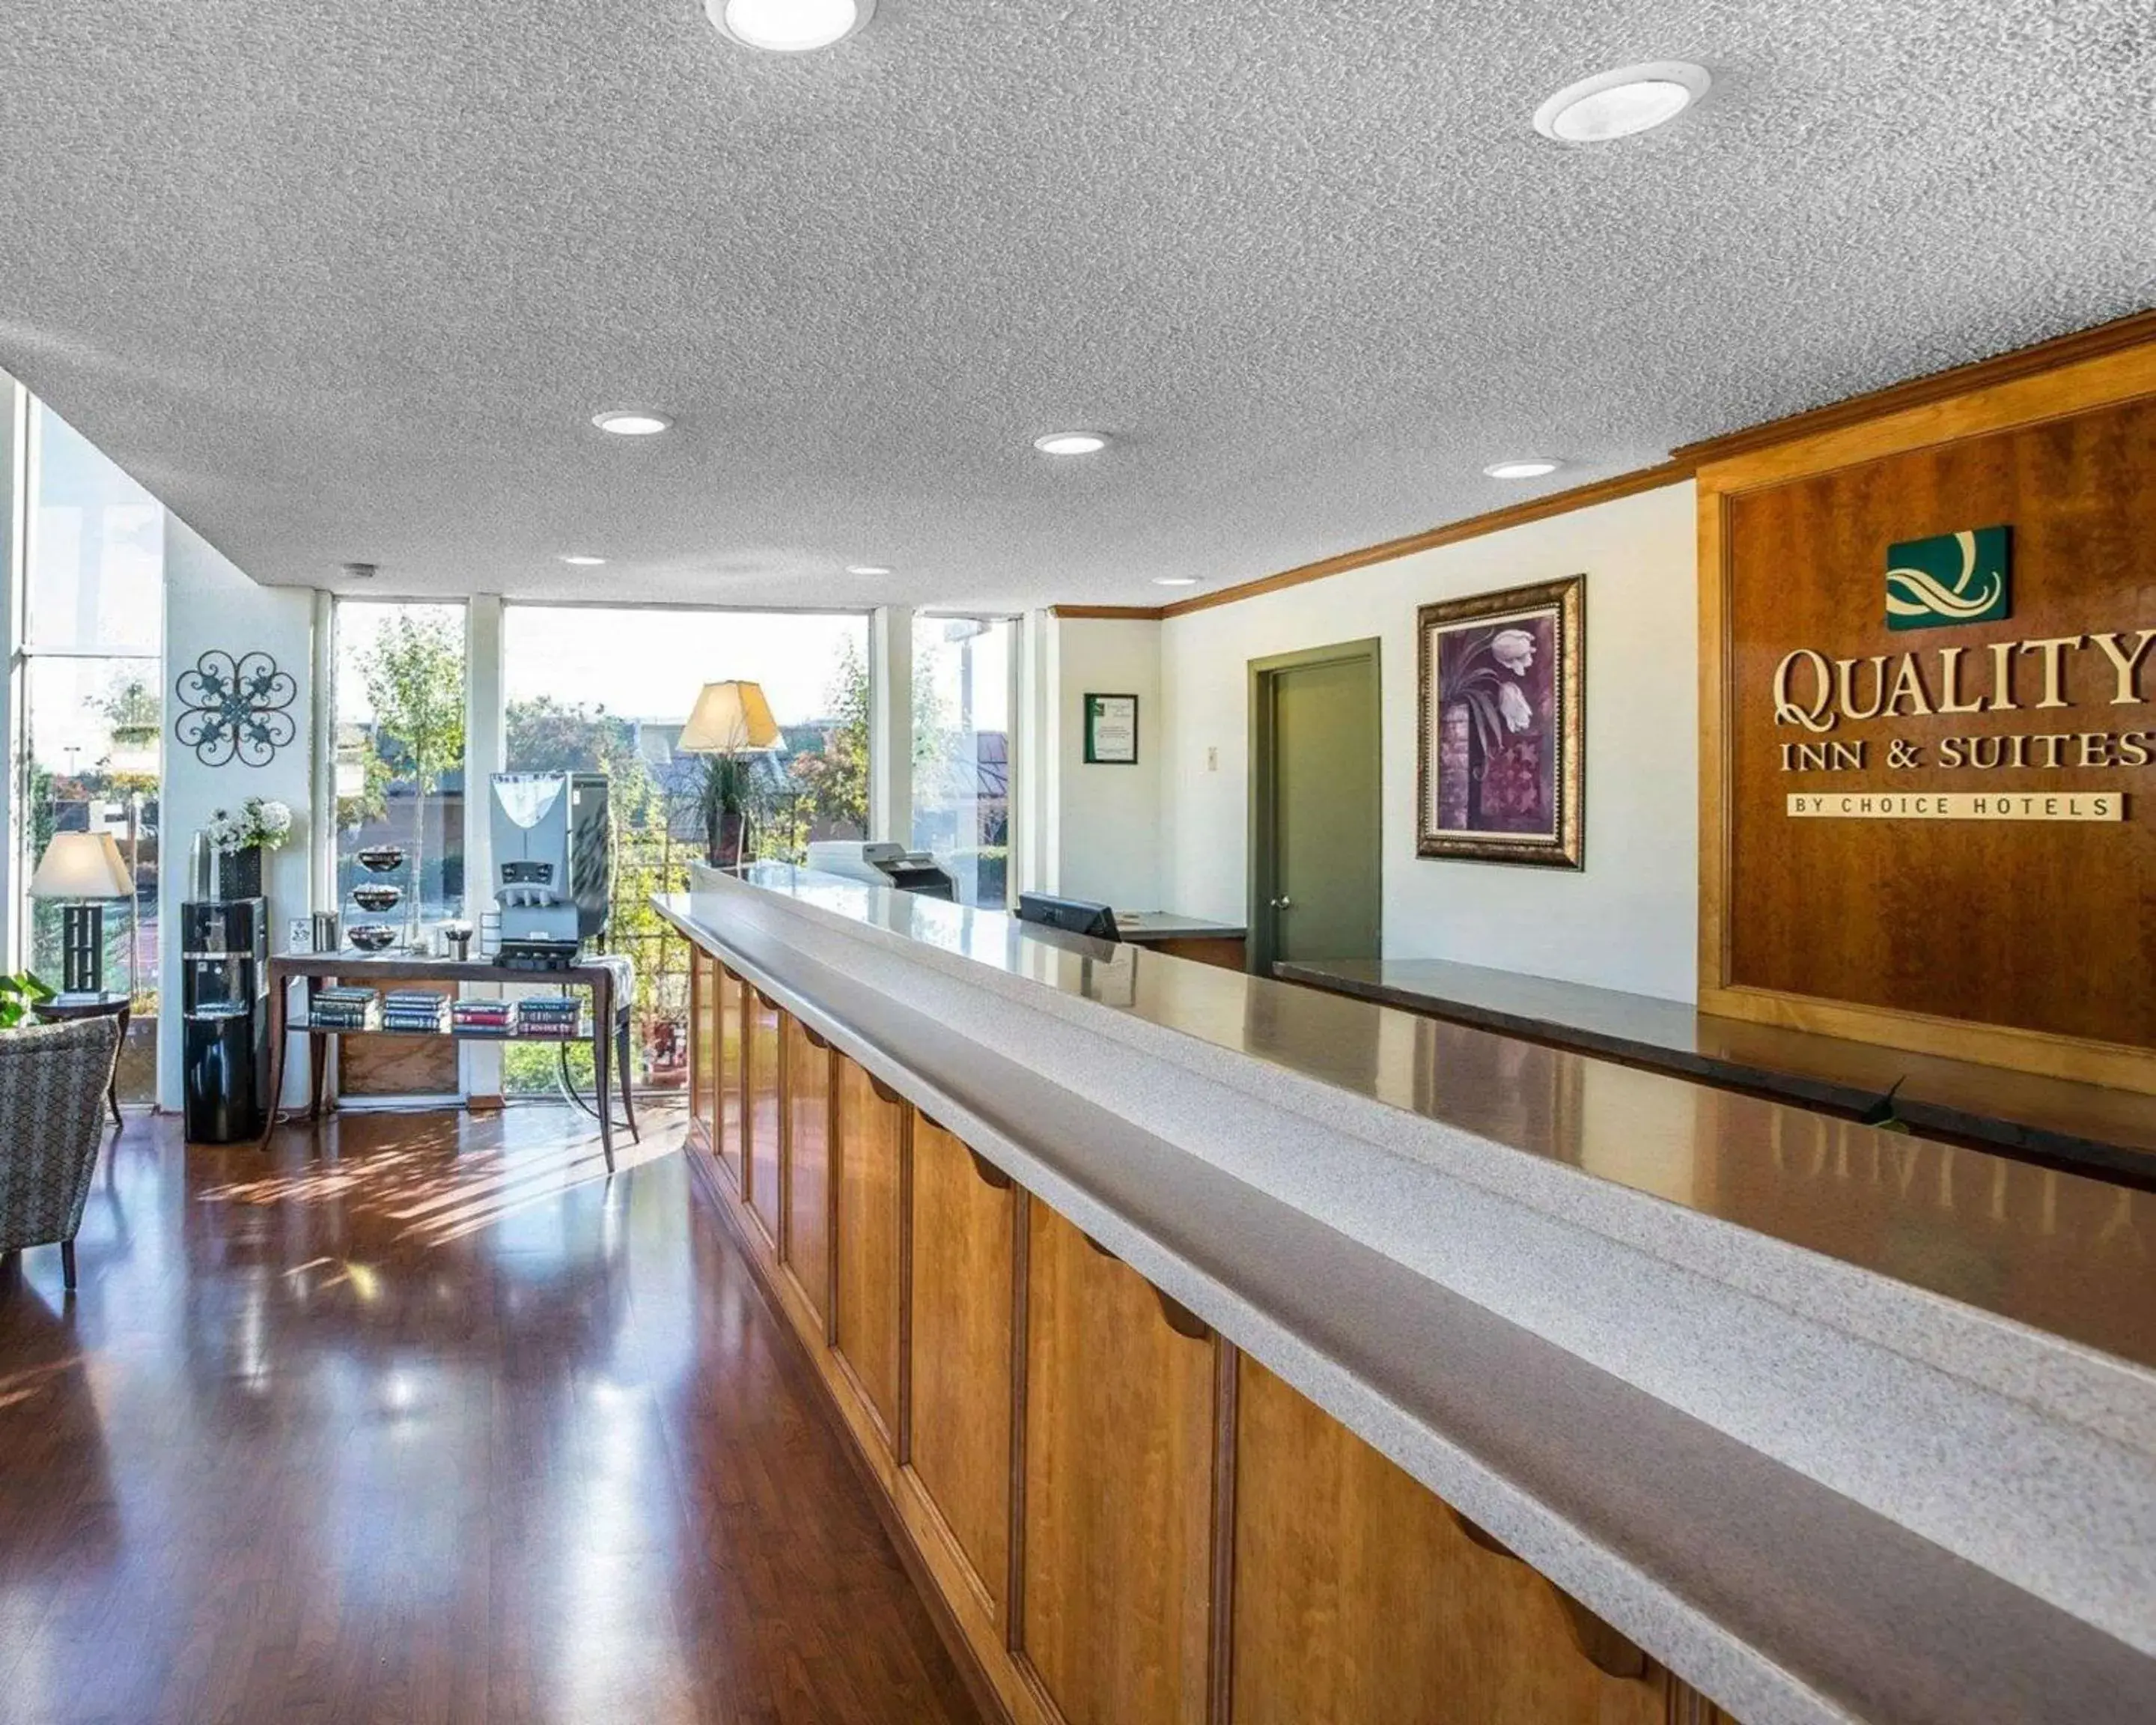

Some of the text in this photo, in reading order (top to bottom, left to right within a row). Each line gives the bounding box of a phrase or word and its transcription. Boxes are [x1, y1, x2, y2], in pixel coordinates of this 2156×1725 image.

[1773, 630, 2156, 731] QUALITY
[1779, 731, 2149, 772] INN & SUITES
[1796, 797, 2108, 816] BY CHOICE HOTELS
